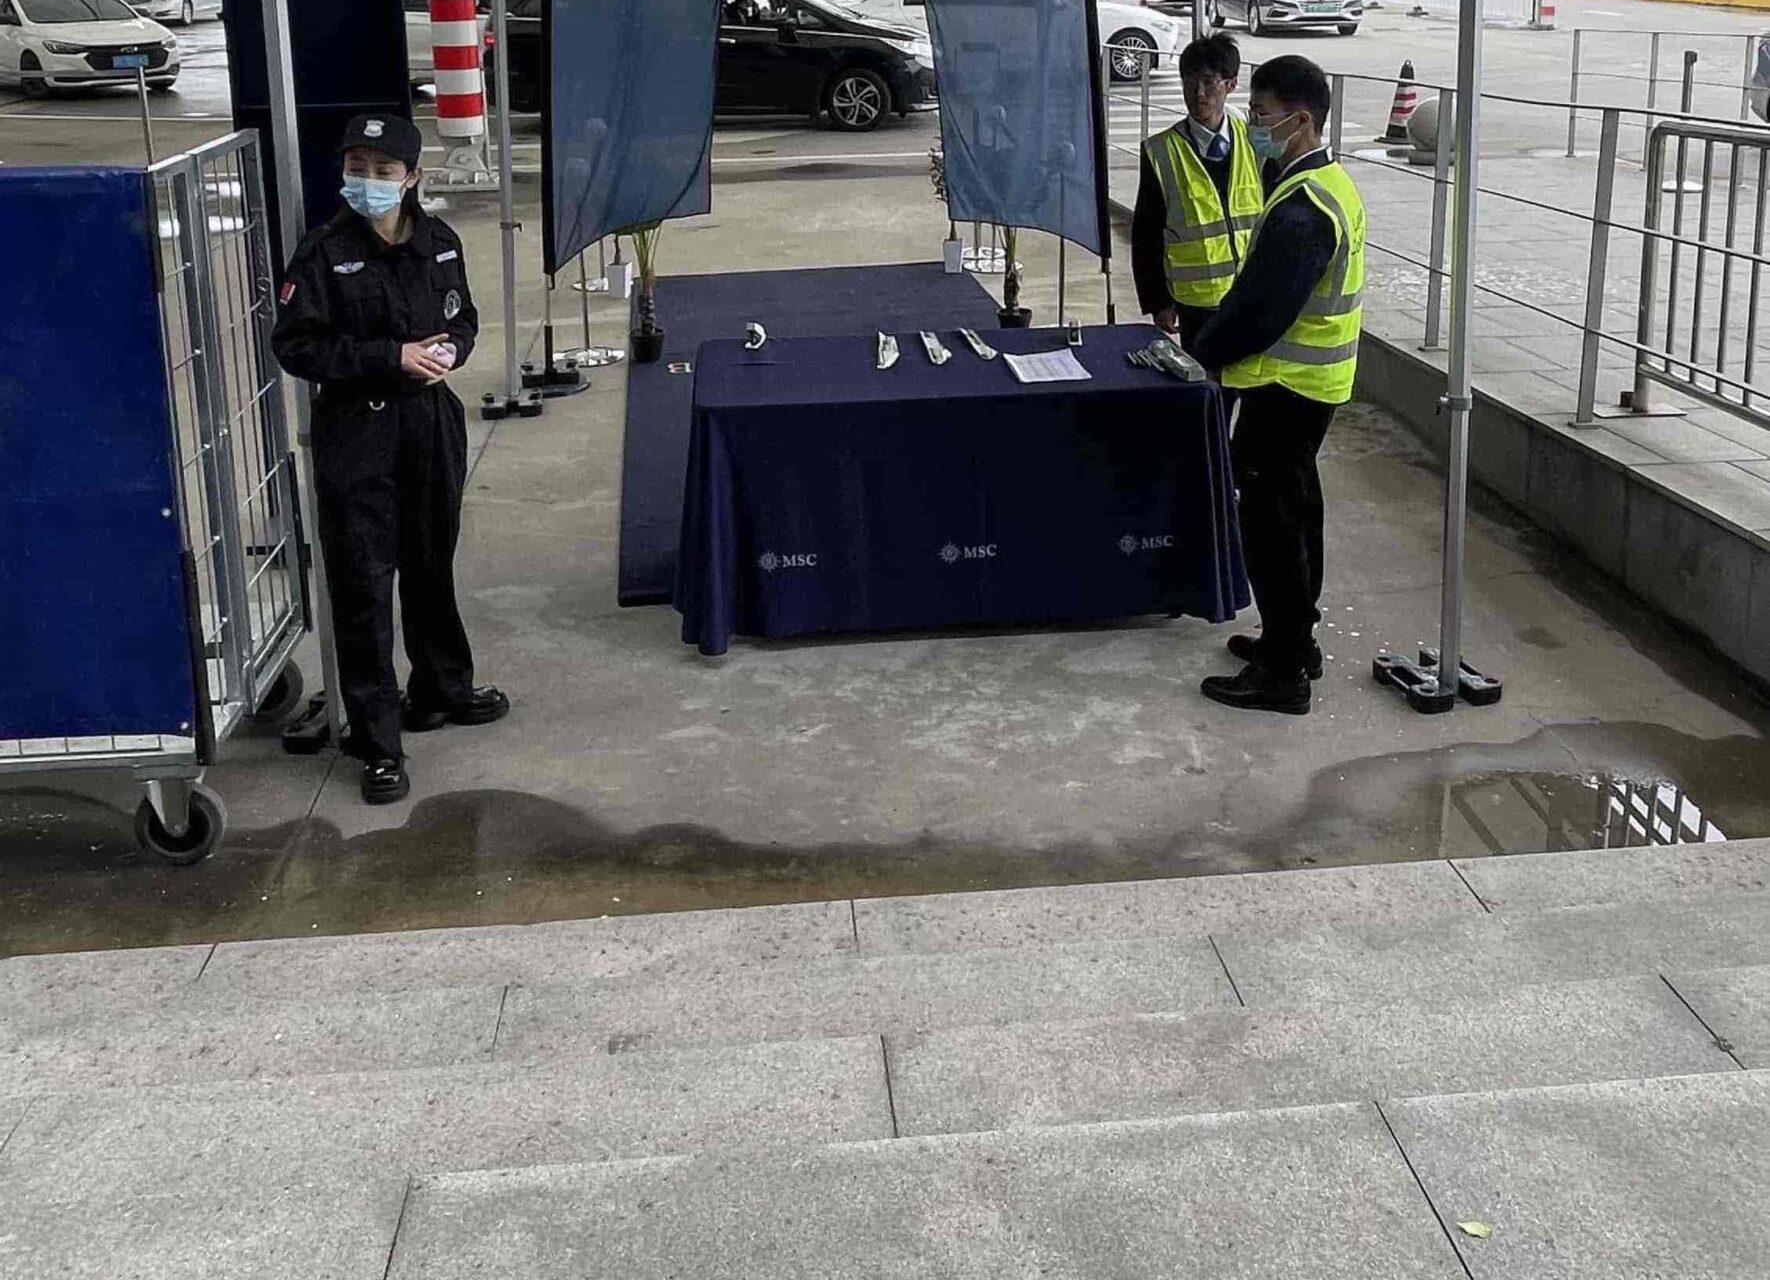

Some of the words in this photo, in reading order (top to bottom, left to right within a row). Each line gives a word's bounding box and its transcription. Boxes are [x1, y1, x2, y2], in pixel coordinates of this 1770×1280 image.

[1140, 534, 1174, 550] MSC
[963, 544, 998, 560] MSC
[782, 553, 818, 568] MSC
